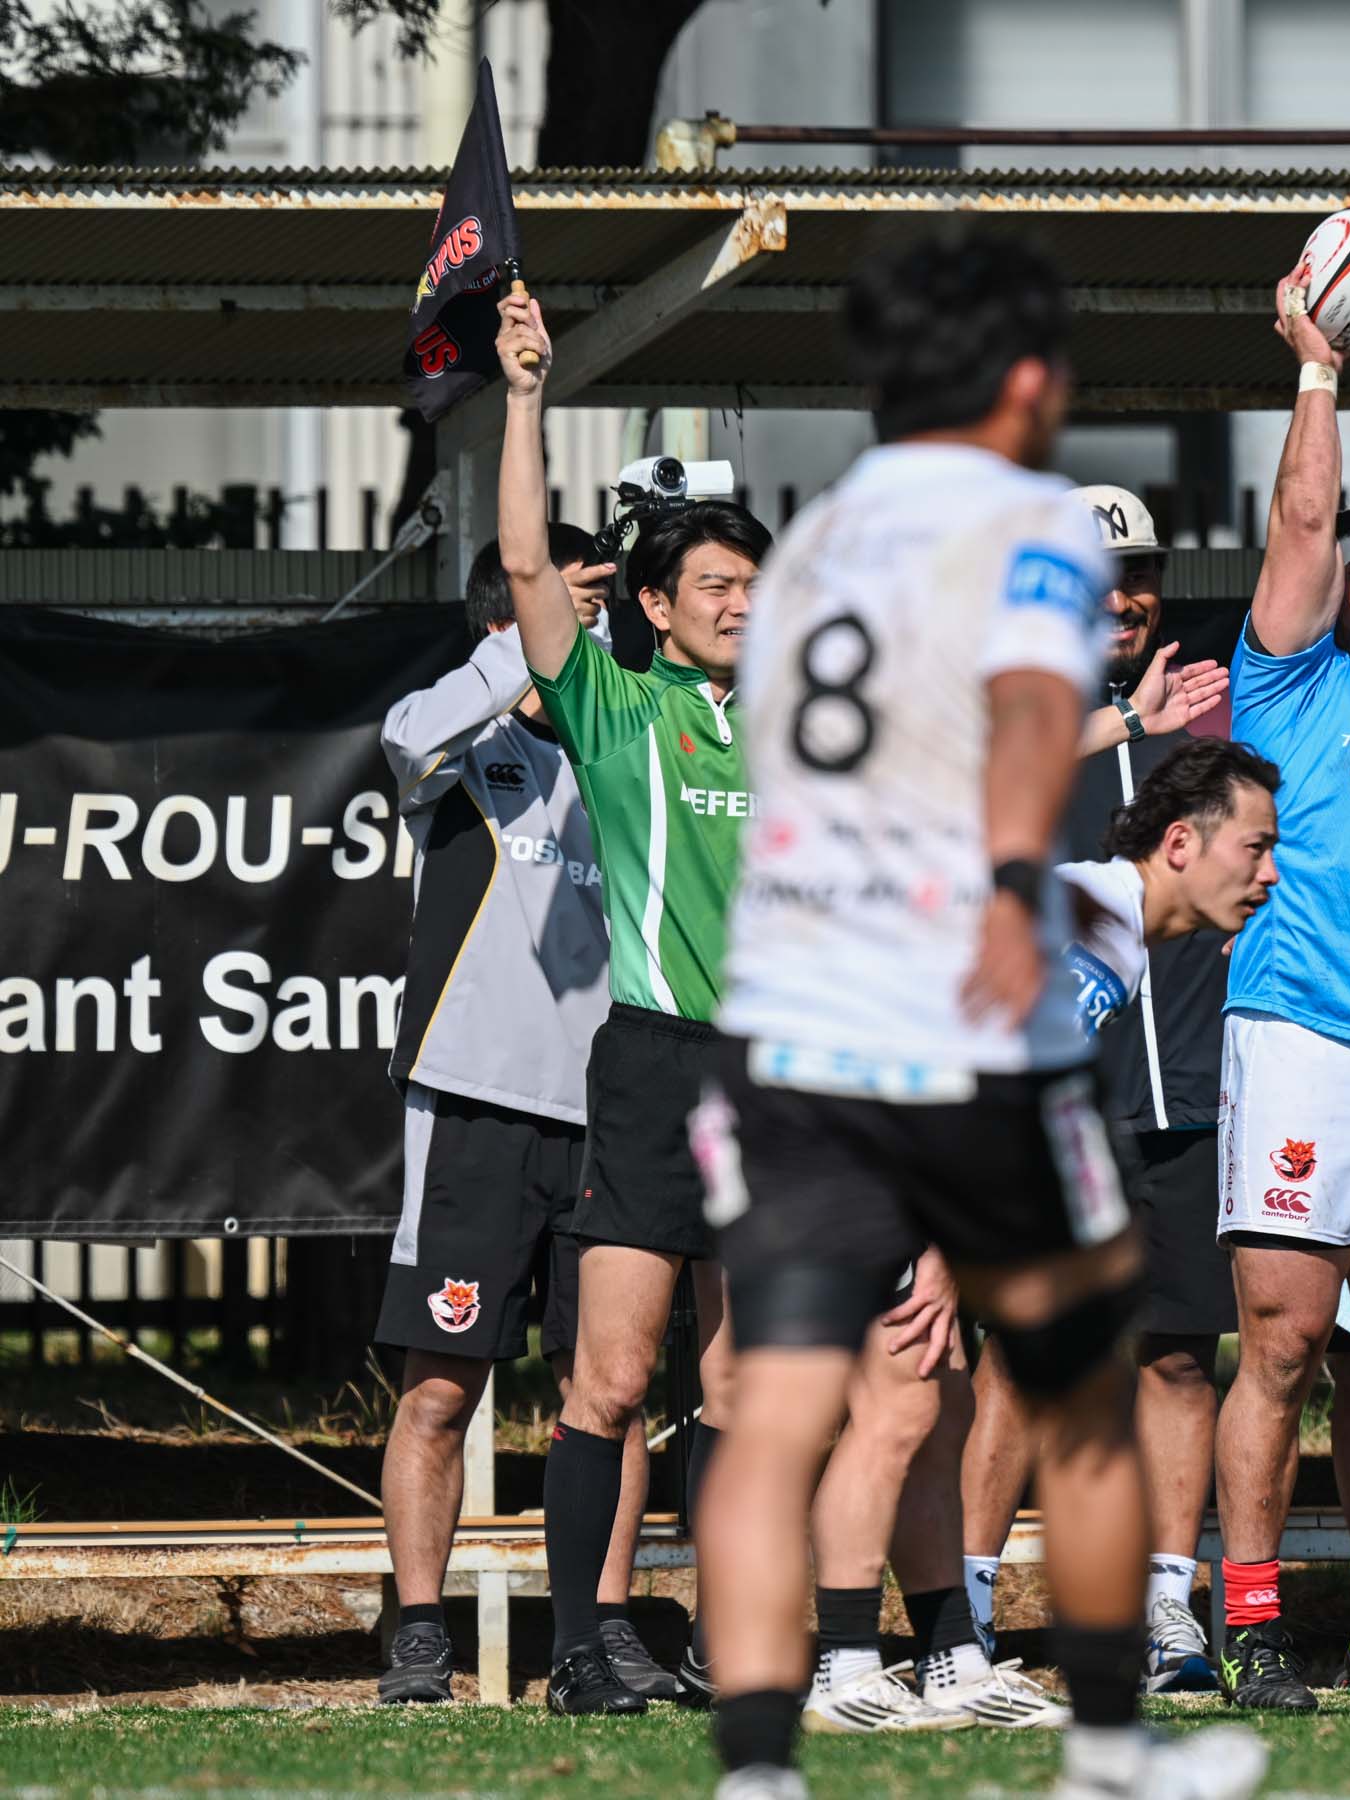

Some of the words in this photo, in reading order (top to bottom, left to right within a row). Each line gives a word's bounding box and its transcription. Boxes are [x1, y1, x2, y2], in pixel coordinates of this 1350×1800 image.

[790, 608, 877, 774] 8
[0, 791, 414, 883] -ROU-S
[1261, 1209, 1310, 1224] canterbury
